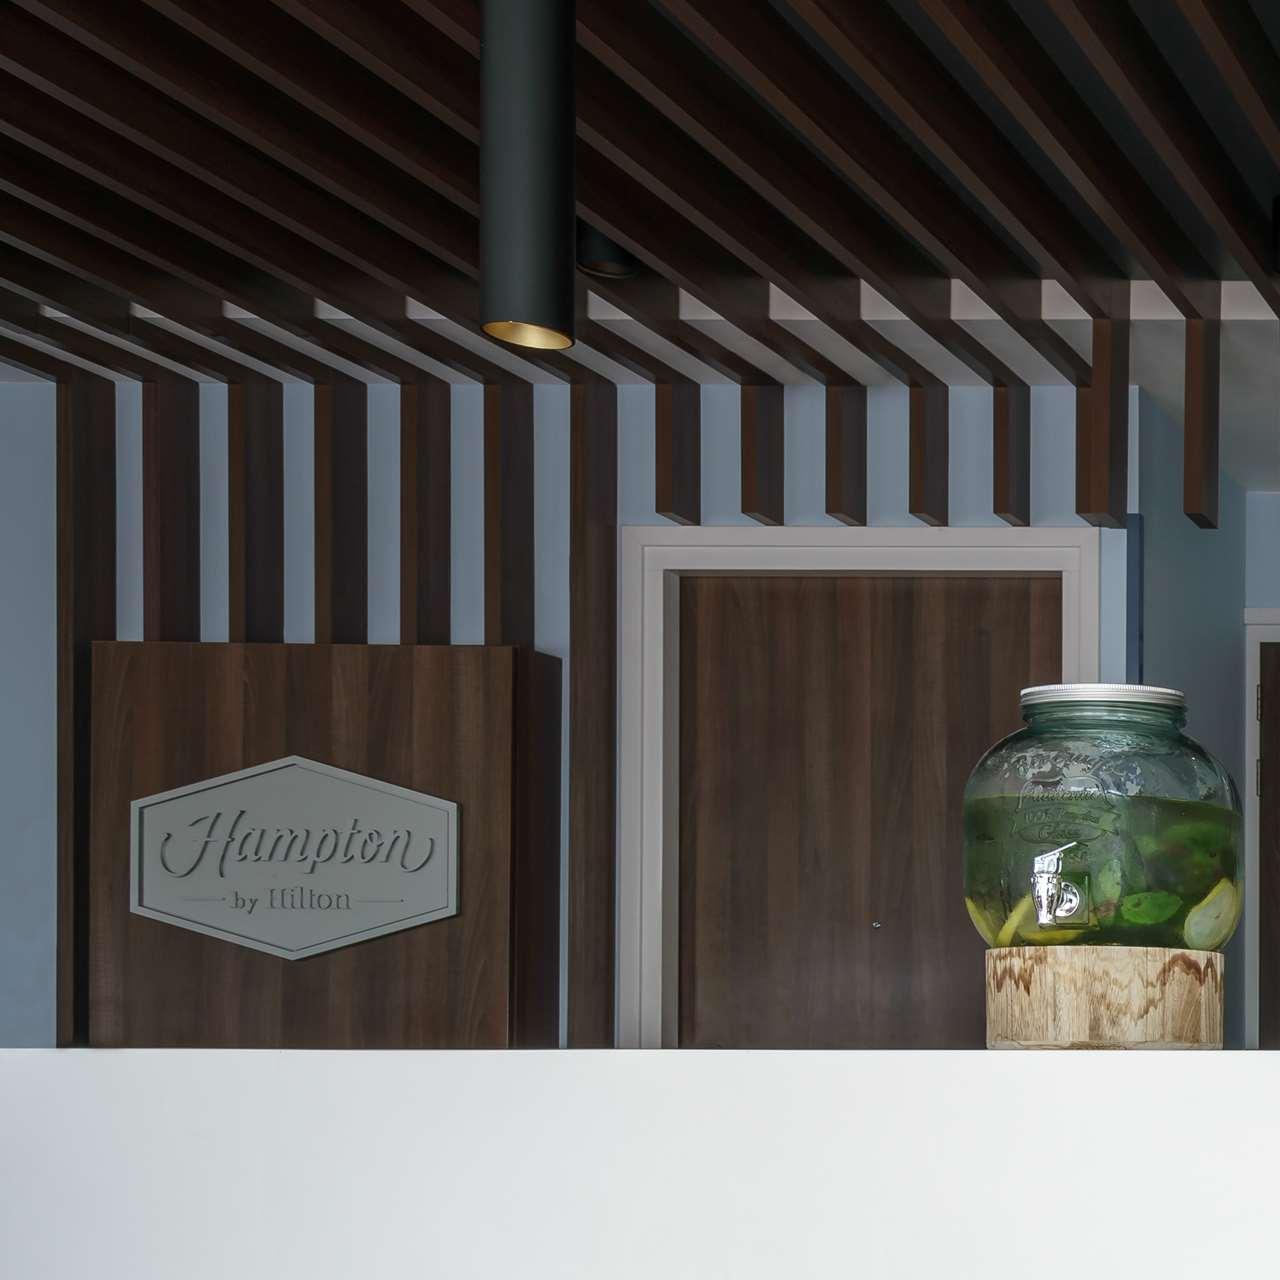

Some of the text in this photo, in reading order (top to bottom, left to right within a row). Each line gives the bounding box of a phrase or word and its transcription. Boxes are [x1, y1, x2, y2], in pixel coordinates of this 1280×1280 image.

[160, 809, 435, 878] Hampton
[231, 885, 352, 914] by Hilton
